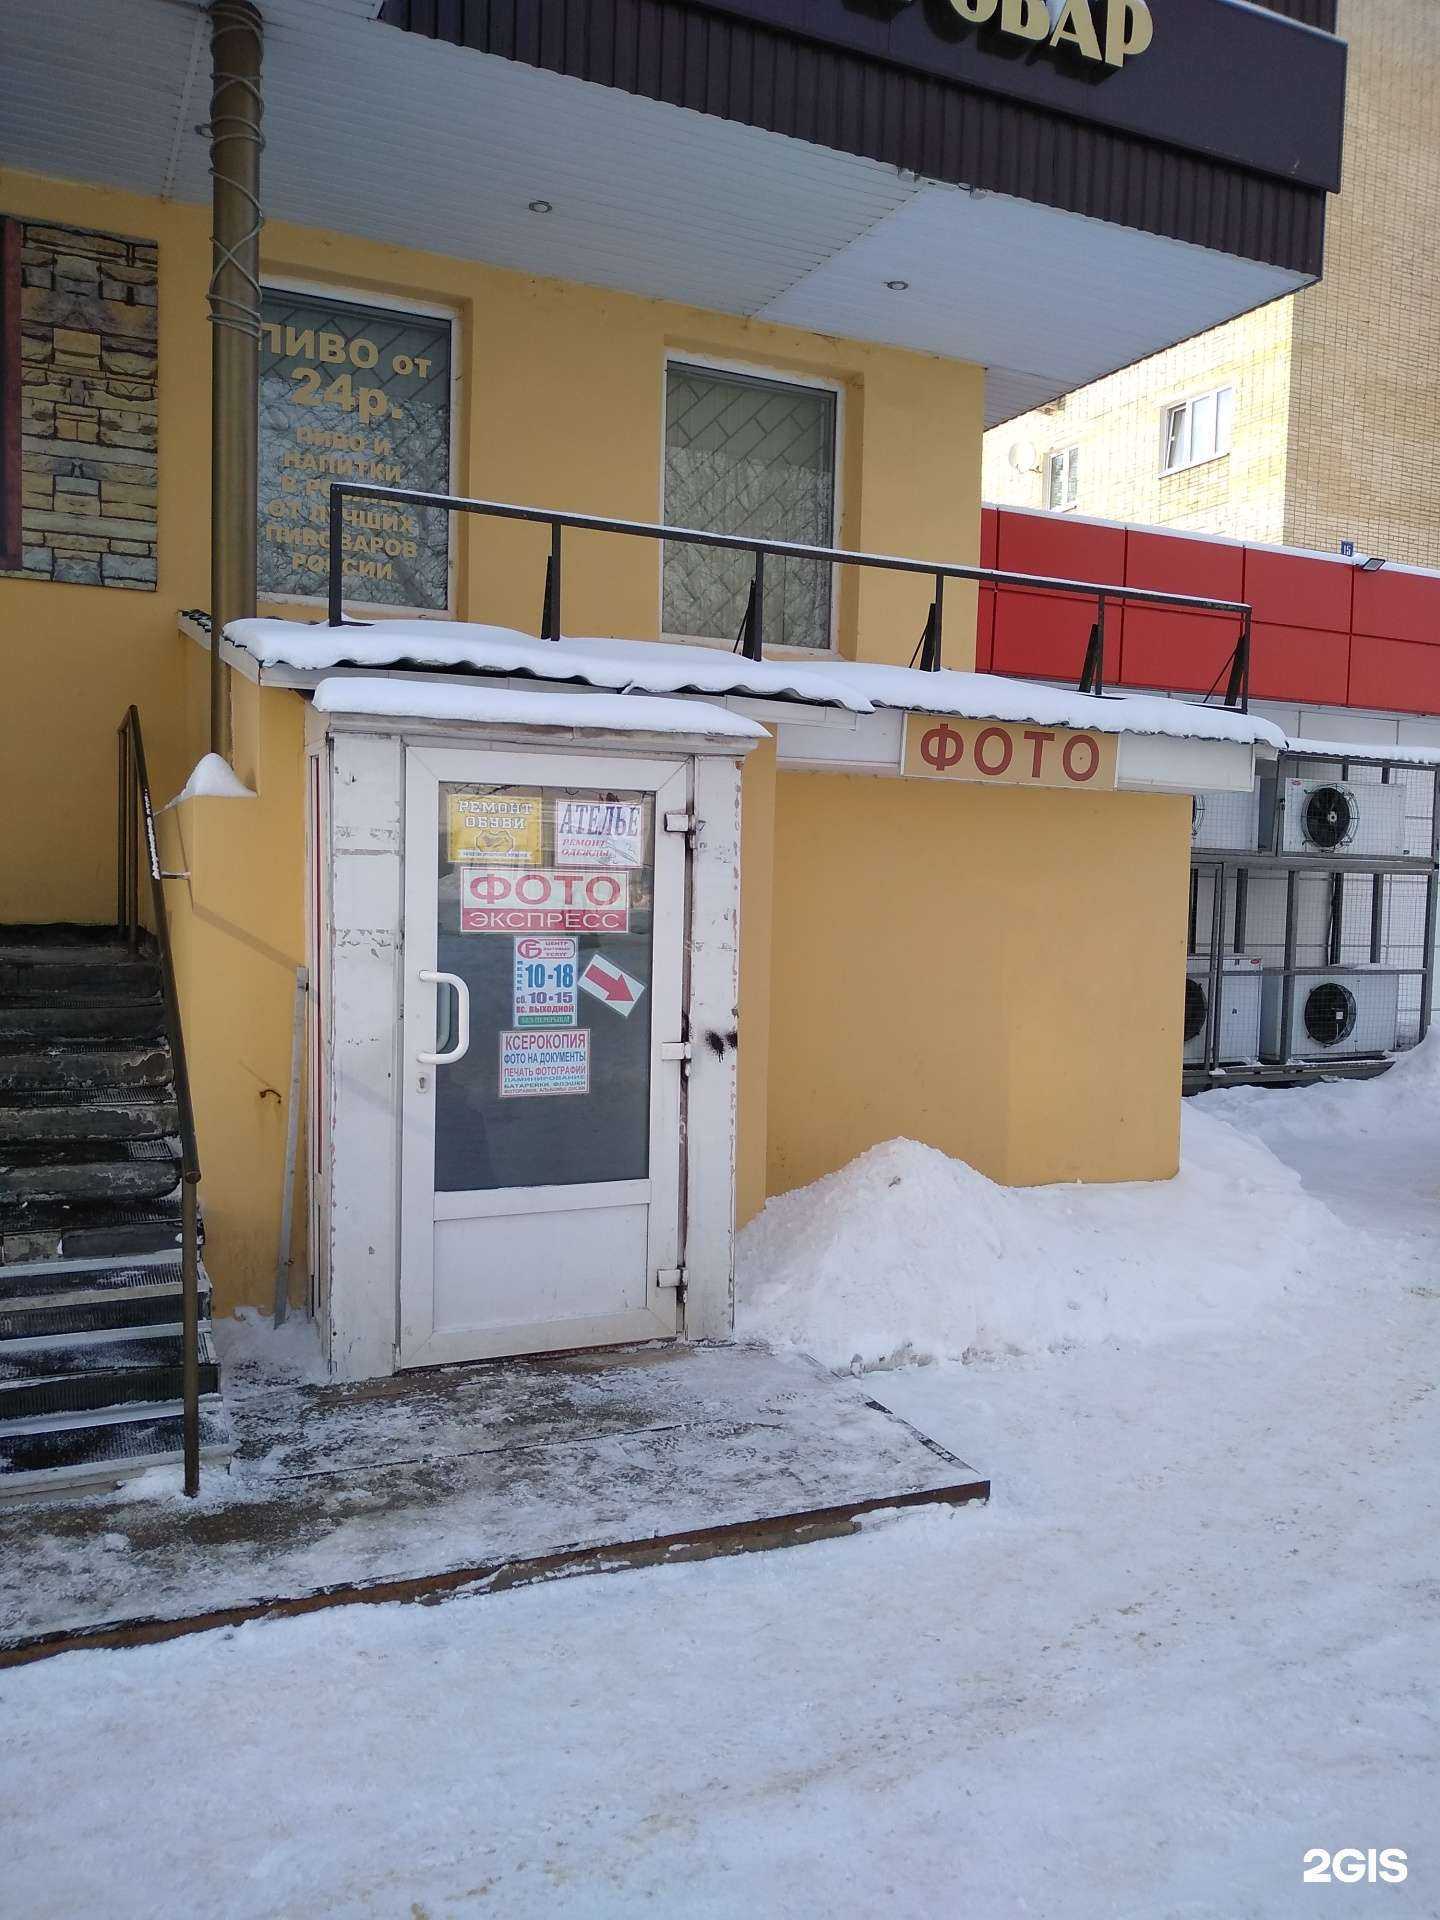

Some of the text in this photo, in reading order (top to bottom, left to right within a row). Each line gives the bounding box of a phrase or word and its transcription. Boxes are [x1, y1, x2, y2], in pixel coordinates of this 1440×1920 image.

[261, 323, 432, 378] ПИВО от
[291, 367, 403, 424] 24р.
[283, 451, 401, 483] НАПИТКИ
[309, 504, 415, 533] ЛЧШИХ
[920, 723, 1099, 781] ФОТО
[458, 800, 532, 815] РЕМОНТ
[465, 816, 526, 829] ОБУВИ
[559, 804, 641, 836] АТЕЛЬЕ
[562, 839, 608, 847] РЕМОНТ
[470, 873, 621, 906] ФОТО
[469, 912, 619, 928] ЭКСПРЕСС
[505, 1033, 586, 1050] КСЕРОКОПИЯ
[504, 1051, 586, 1065] ФОТО НА ДОКУМЕНТЫ
[504, 1067, 533, 1077] ПЕЧАТЬ
